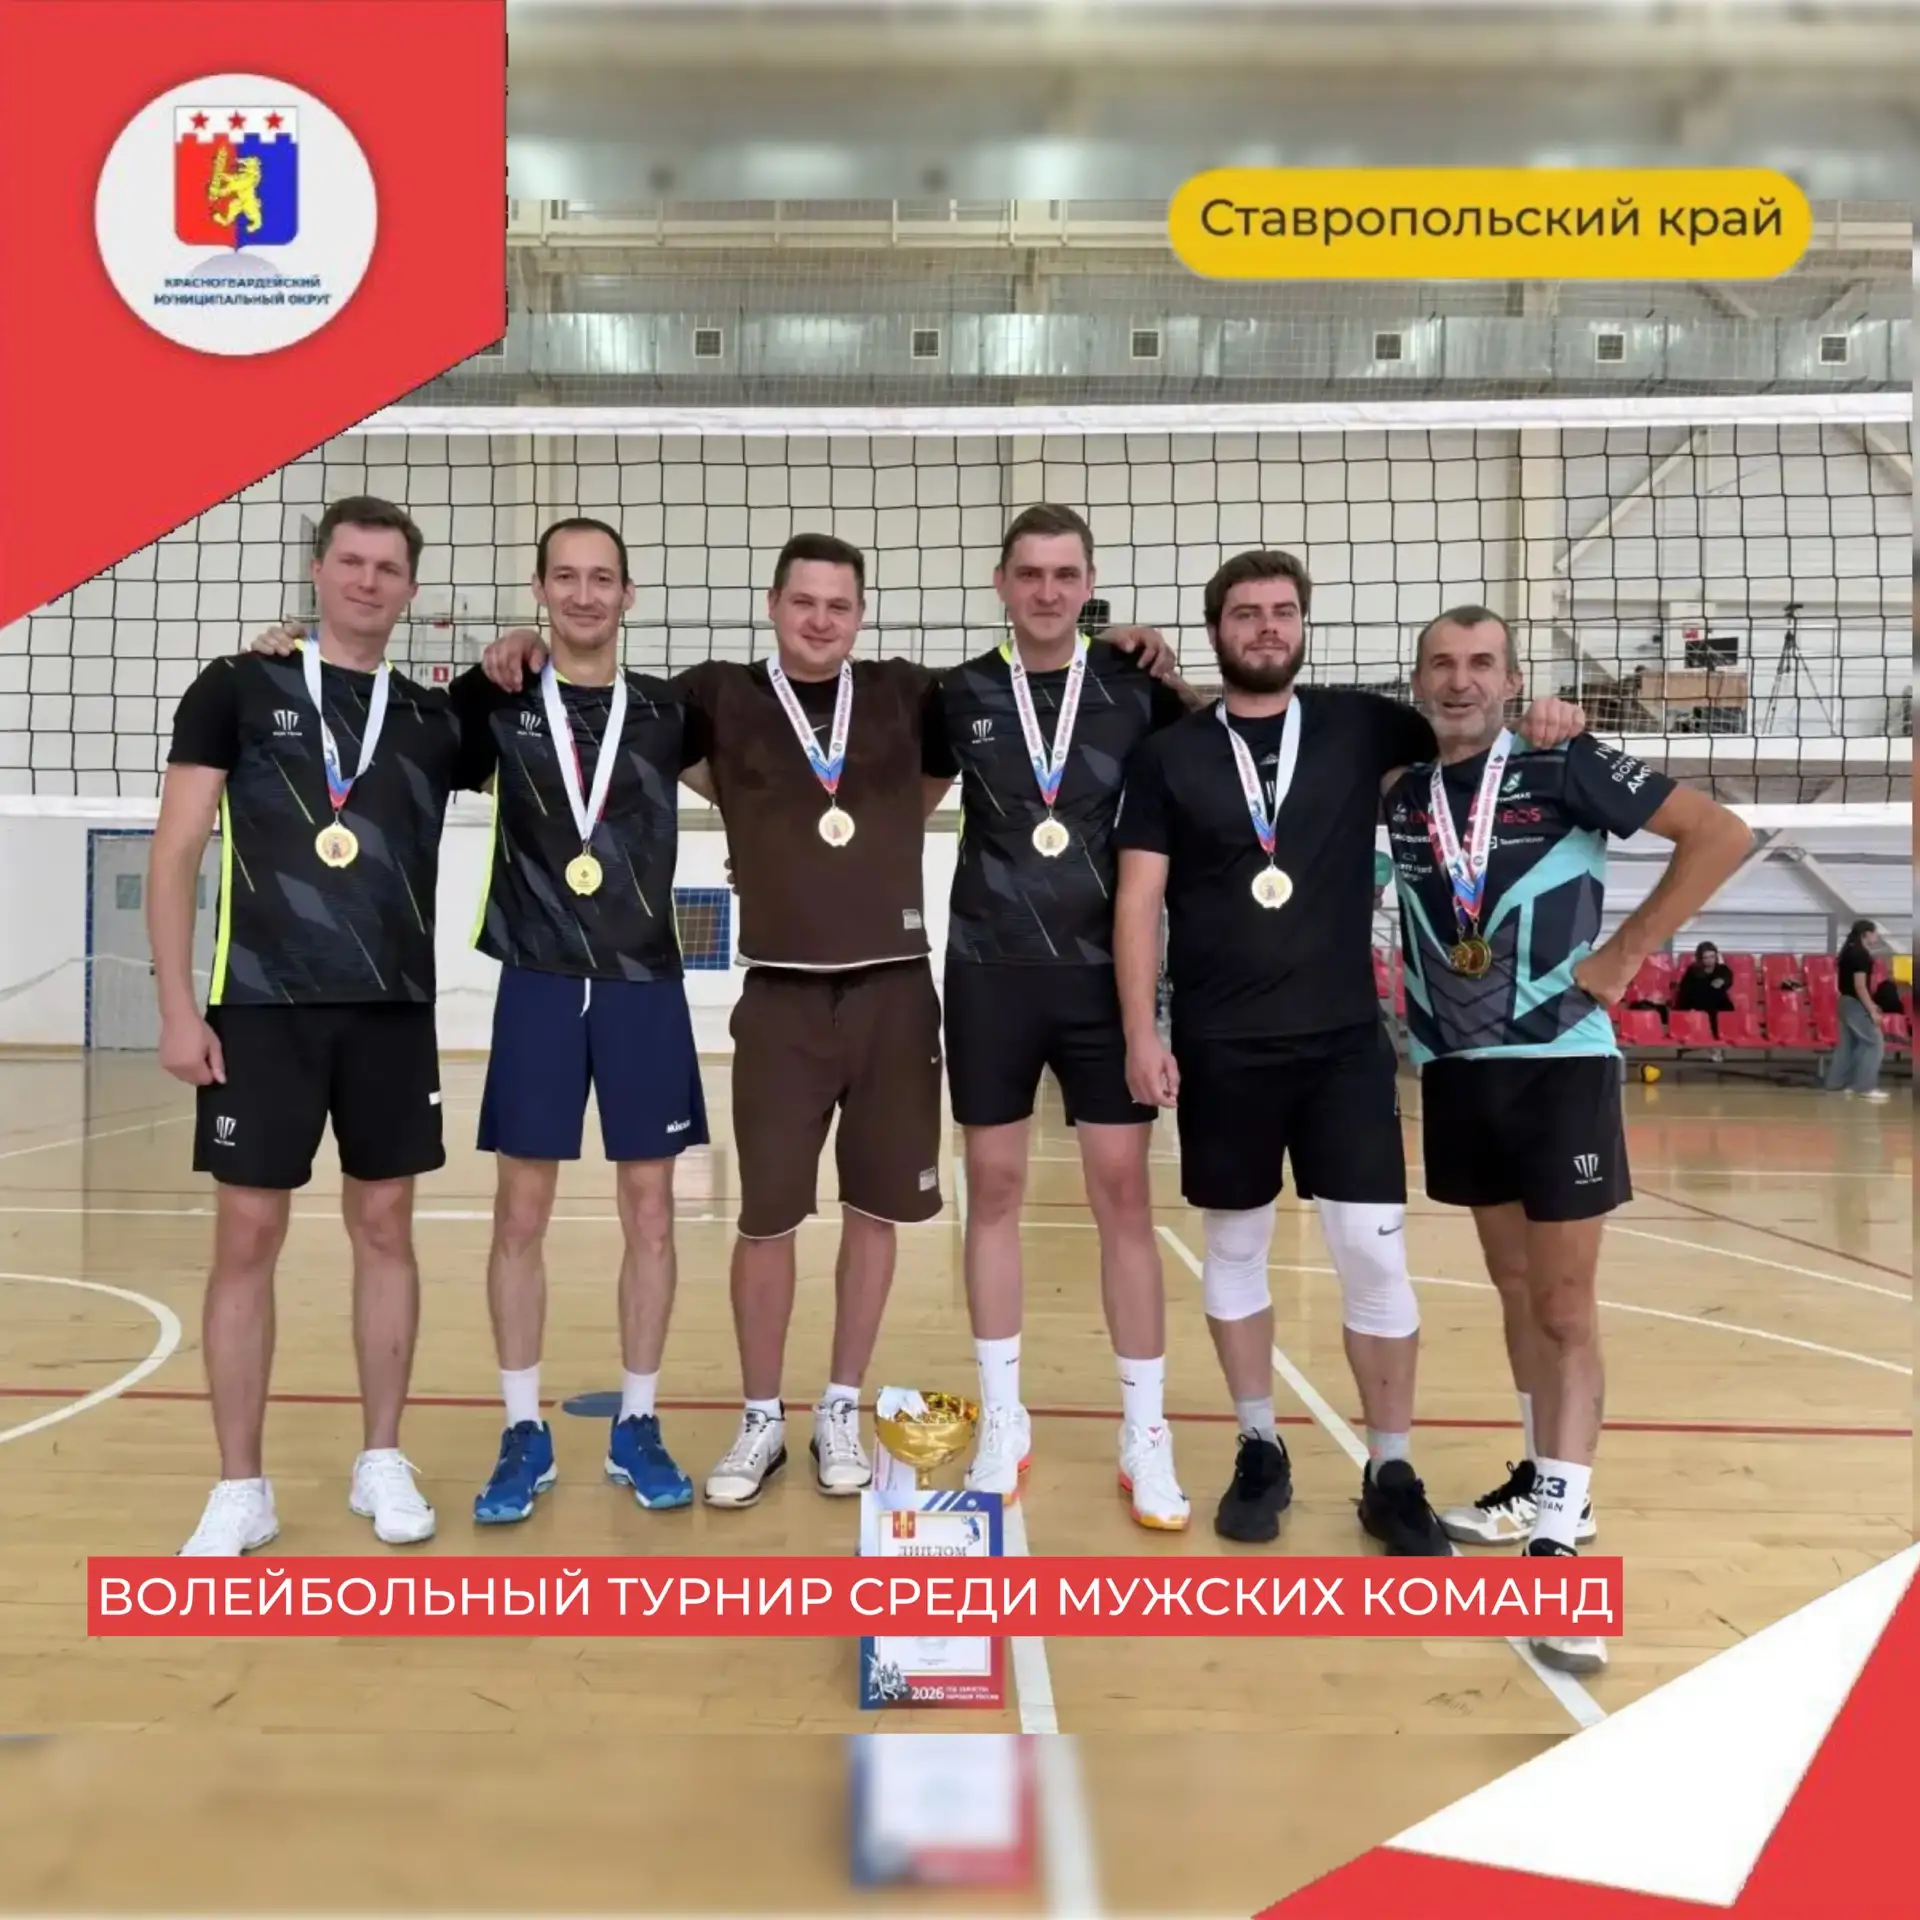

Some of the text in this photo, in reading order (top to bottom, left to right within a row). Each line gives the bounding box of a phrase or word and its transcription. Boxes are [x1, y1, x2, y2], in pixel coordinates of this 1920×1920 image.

[1532, 1473, 1568, 1499] 23
[898, 1545, 967, 1557] ДИПЛОМ
[911, 1686, 945, 1700] 2026
